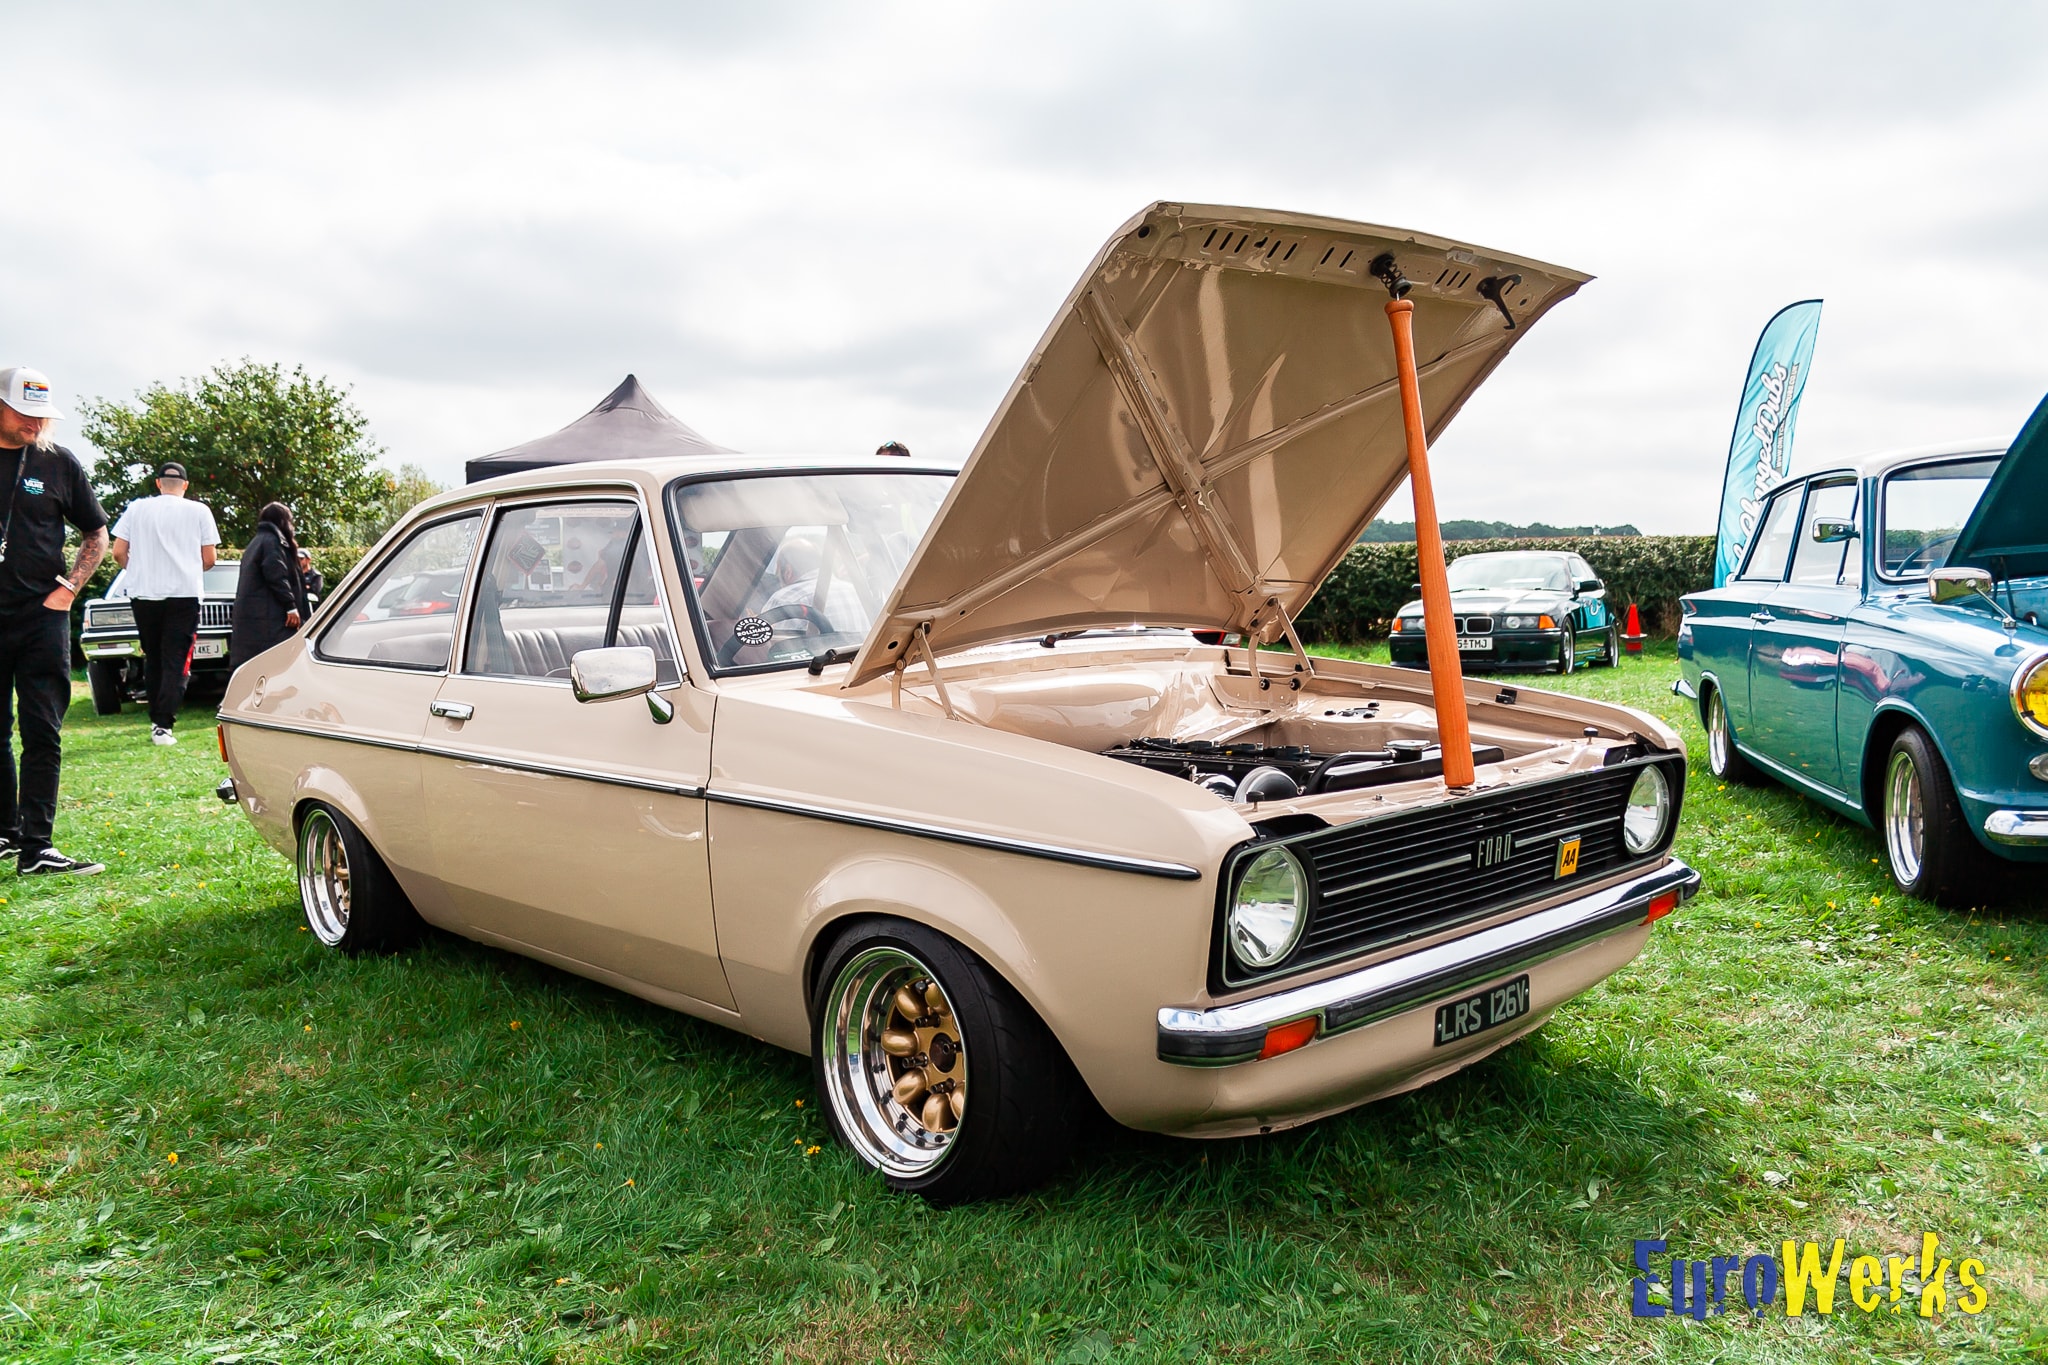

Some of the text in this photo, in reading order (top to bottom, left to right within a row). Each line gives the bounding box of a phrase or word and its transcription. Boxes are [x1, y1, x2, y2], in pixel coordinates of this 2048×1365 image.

[735, 618, 767, 631] BICESTER
[740, 631, 772, 645] HERITAGE
[1469, 639, 1487, 648] TMJ
[1477, 832, 1513, 869] FORD
[1561, 848, 1576, 868] AA
[1440, 979, 1526, 1042] LRS 126V
